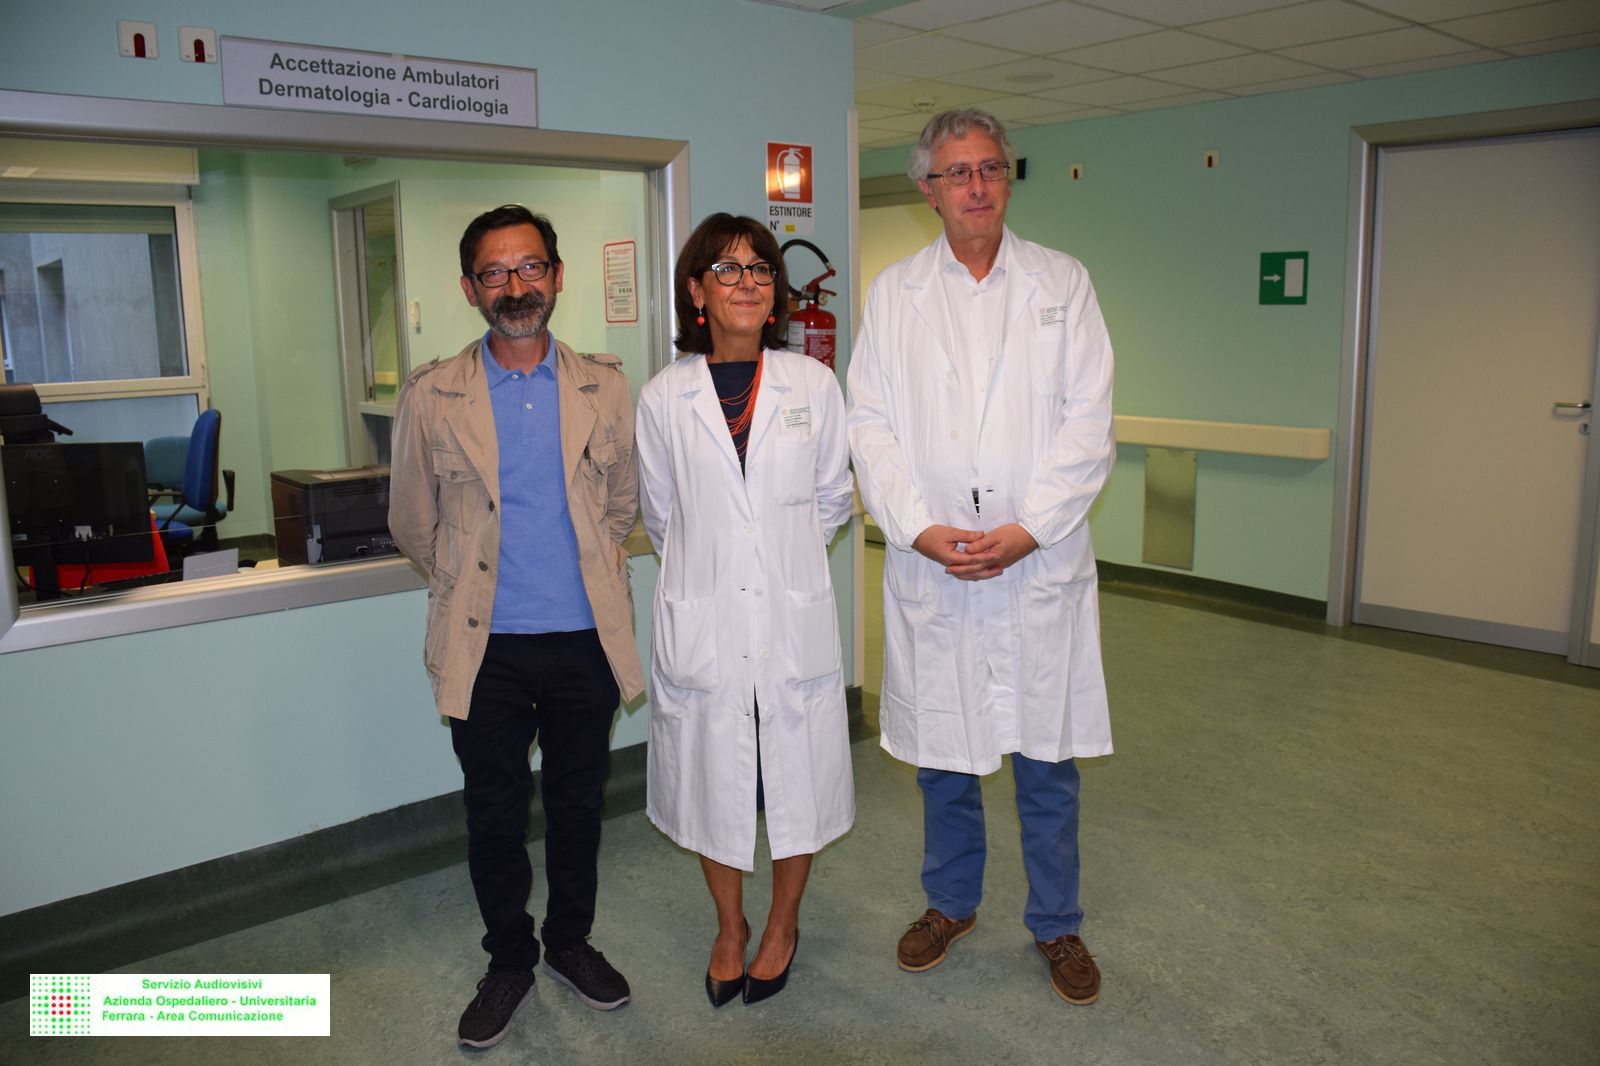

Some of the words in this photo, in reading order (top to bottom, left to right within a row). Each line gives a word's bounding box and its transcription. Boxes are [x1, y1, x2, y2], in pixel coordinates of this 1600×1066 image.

[270, 53, 396, 80] Accettazione
[402, 66, 499, 90] Ambulatori
[259, 78, 391, 108] Dermatologia
[408, 91, 509, 117] Cardiologia
[769, 205, 812, 218] ESTINTORE
